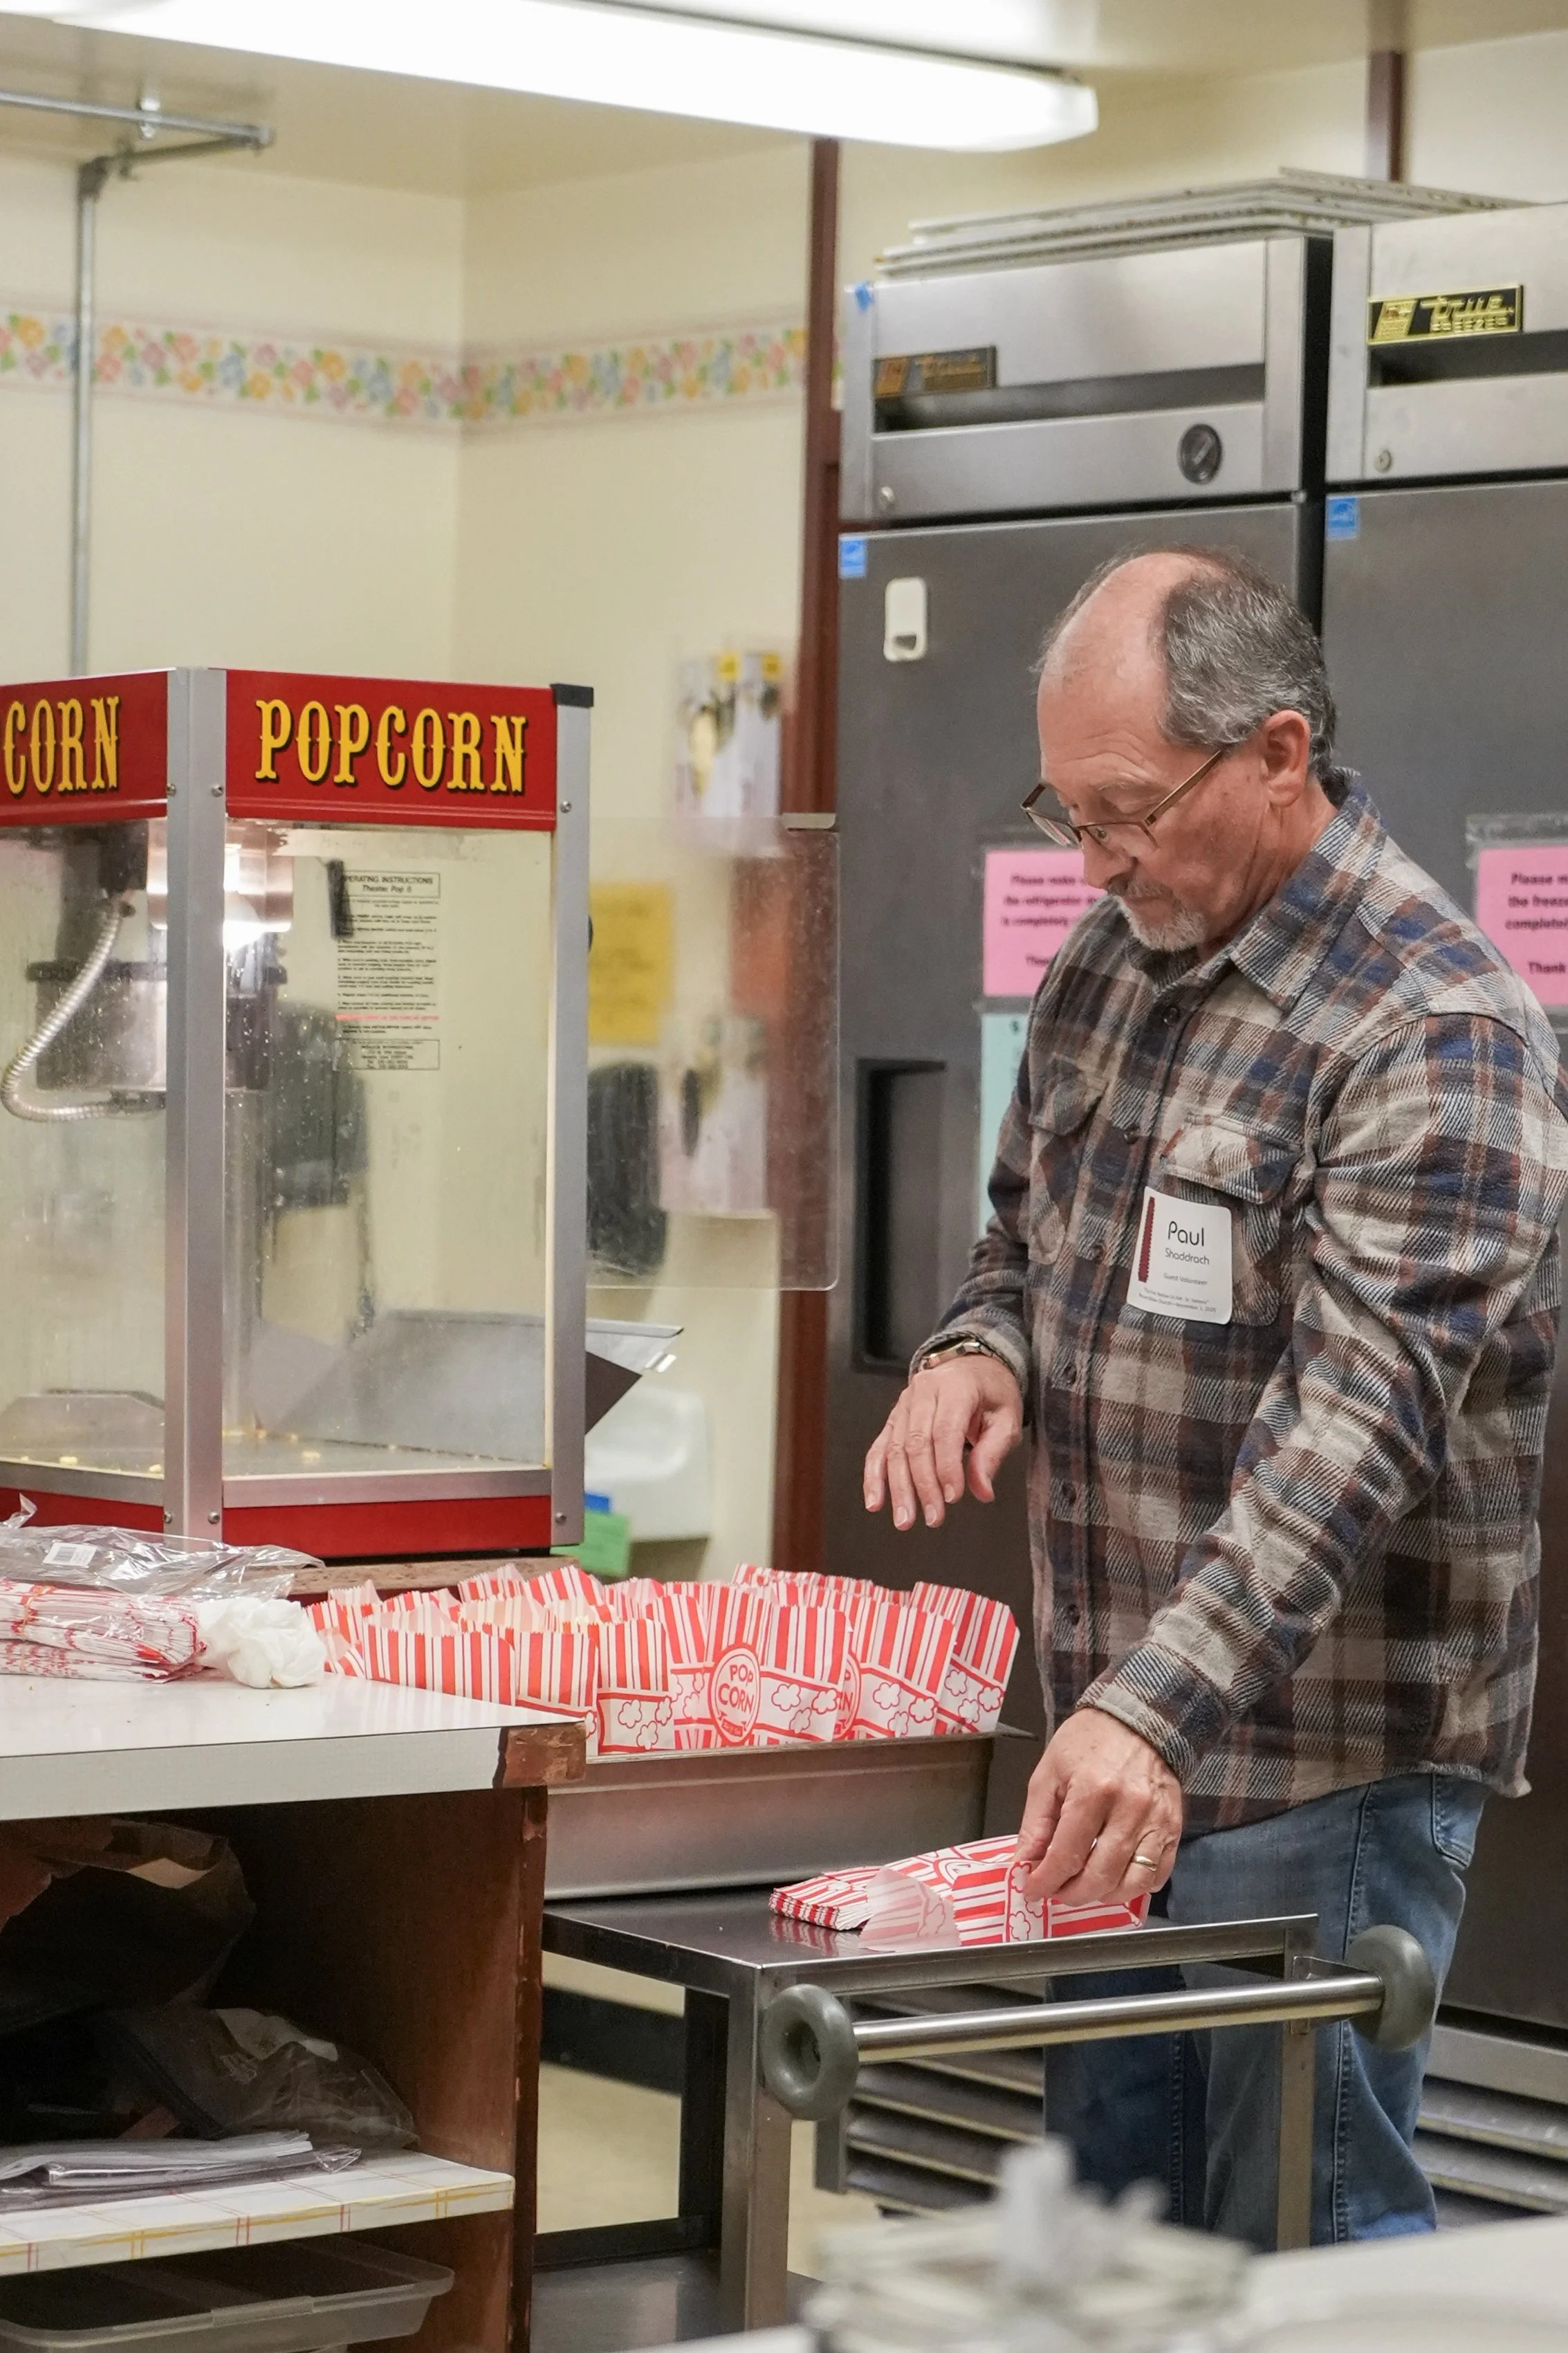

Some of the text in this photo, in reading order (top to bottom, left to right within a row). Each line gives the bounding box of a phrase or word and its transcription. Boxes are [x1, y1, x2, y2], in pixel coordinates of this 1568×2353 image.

[3, 696, 120, 795] CORN
[255, 698, 527, 794] POPCORN
[341, 875, 433, 885] PERATING INSTRUCTIONS
[1511, 872, 1553, 885] Please
[1509, 895, 1528, 908] the
[1529, 961, 1566, 974] Thank
[1168, 1221, 1204, 1247] Paul
[730, 1664, 753, 1686] POP
[718, 1683, 754, 1714] CORN
